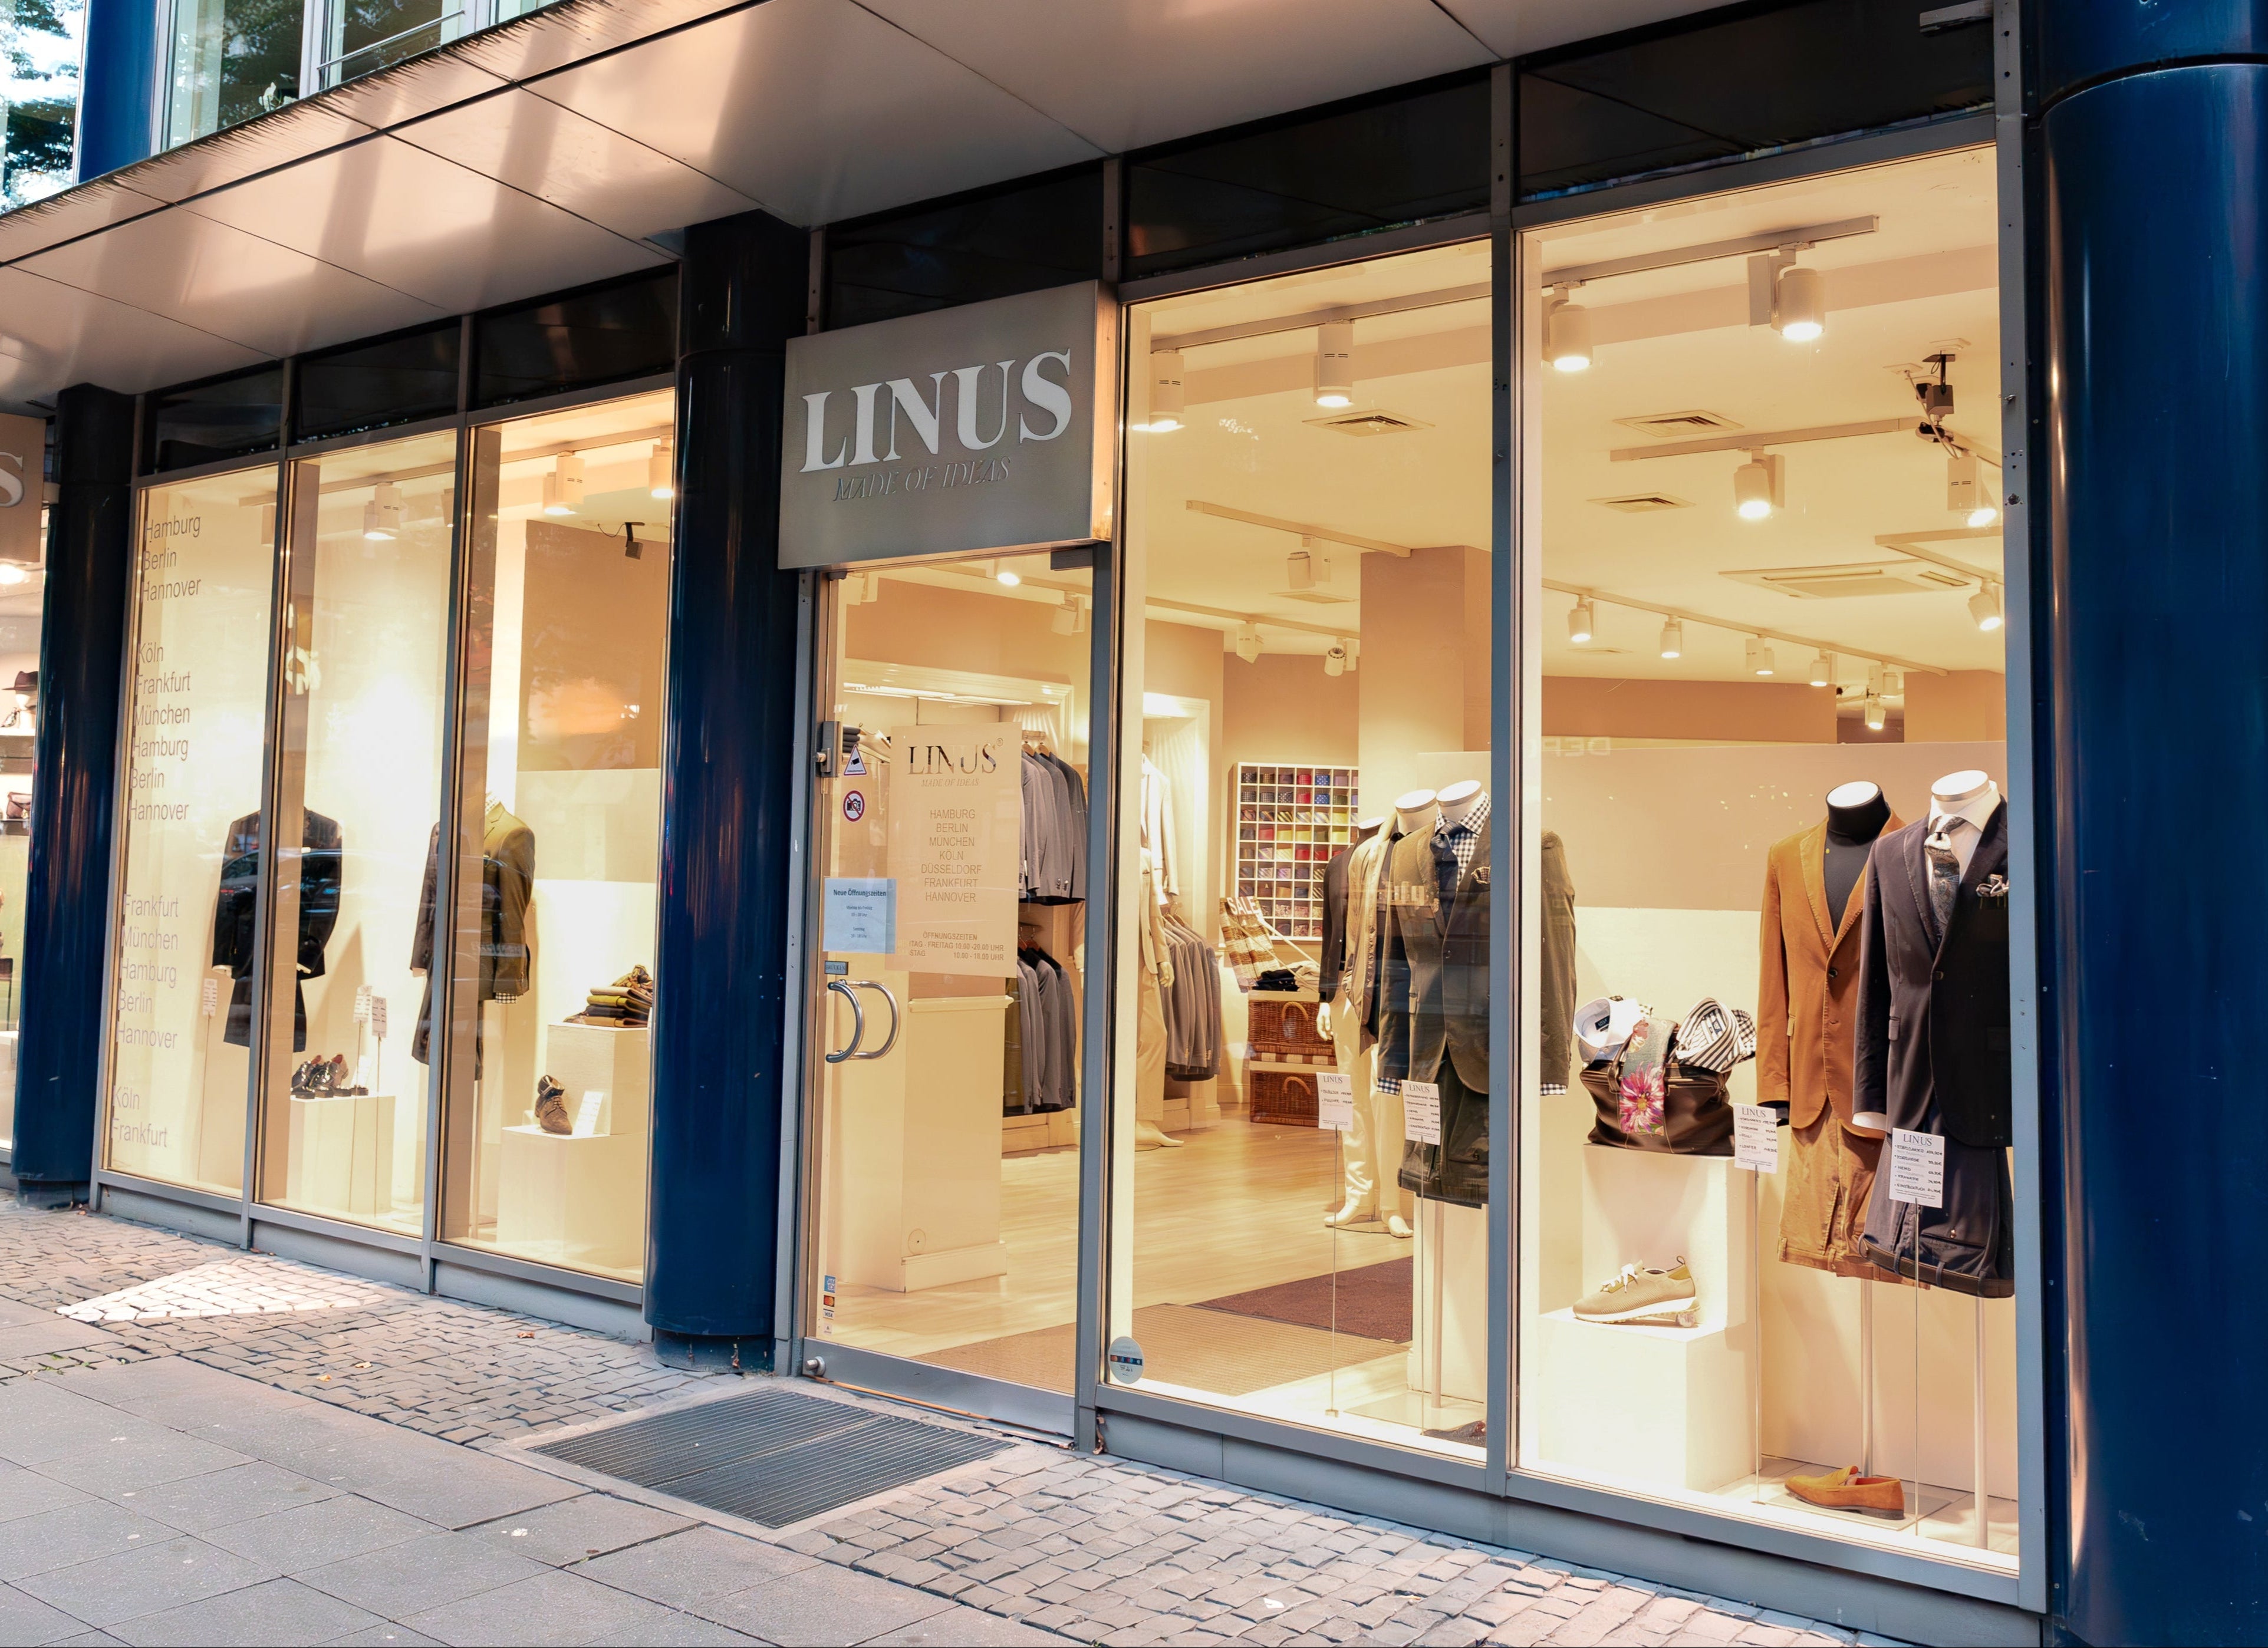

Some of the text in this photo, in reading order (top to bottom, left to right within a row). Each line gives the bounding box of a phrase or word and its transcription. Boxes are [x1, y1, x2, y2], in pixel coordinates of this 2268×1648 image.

[799, 348, 1072, 473] LINUS
[833, 456, 1011, 501] MADE OF IDEAS
[145, 515, 201, 538] Hamburg
[143, 548, 177, 571] Berlin
[141, 579, 202, 601] Hannover
[139, 642, 164, 663] Köln
[136, 671, 191, 695] Frankfurt
[134, 704, 190, 726] München
[131, 736, 189, 761] Hamburg
[130, 767, 164, 789] Berlin
[921, 777, 980, 787] MADE OF IDEAS
[129, 799, 189, 820] Hannover
[930, 809, 975, 819] HAMBURG
[936, 823, 968, 832] BERLIN
[929, 835, 975, 846] MÜNCHEN
[940, 849, 964, 860] KÖLN
[921, 862, 982, 874] DÜSSELDORF
[848, 888, 886, 897] Öffnungszeiten
[924, 878, 978, 887] FRANKFURT
[123, 894, 179, 917] Frankfurt
[925, 892, 976, 902] HANNOVER
[1226, 896, 1260, 915] SALE
[121, 926, 178, 950] München
[923, 931, 977, 940] ÖFFNUNGSZEITEN
[120, 958, 176, 988] Hamburg
[118, 990, 152, 1014] Berlin
[117, 1021, 177, 1049] Hannover
[1324, 1076, 1342, 1084] LINUS
[113, 1086, 140, 1109] Köln
[1742, 1108, 1766, 1118] LINUS
[111, 1118, 167, 1148] Frankfurt
[1902, 1133, 1933, 1146] LINUS
